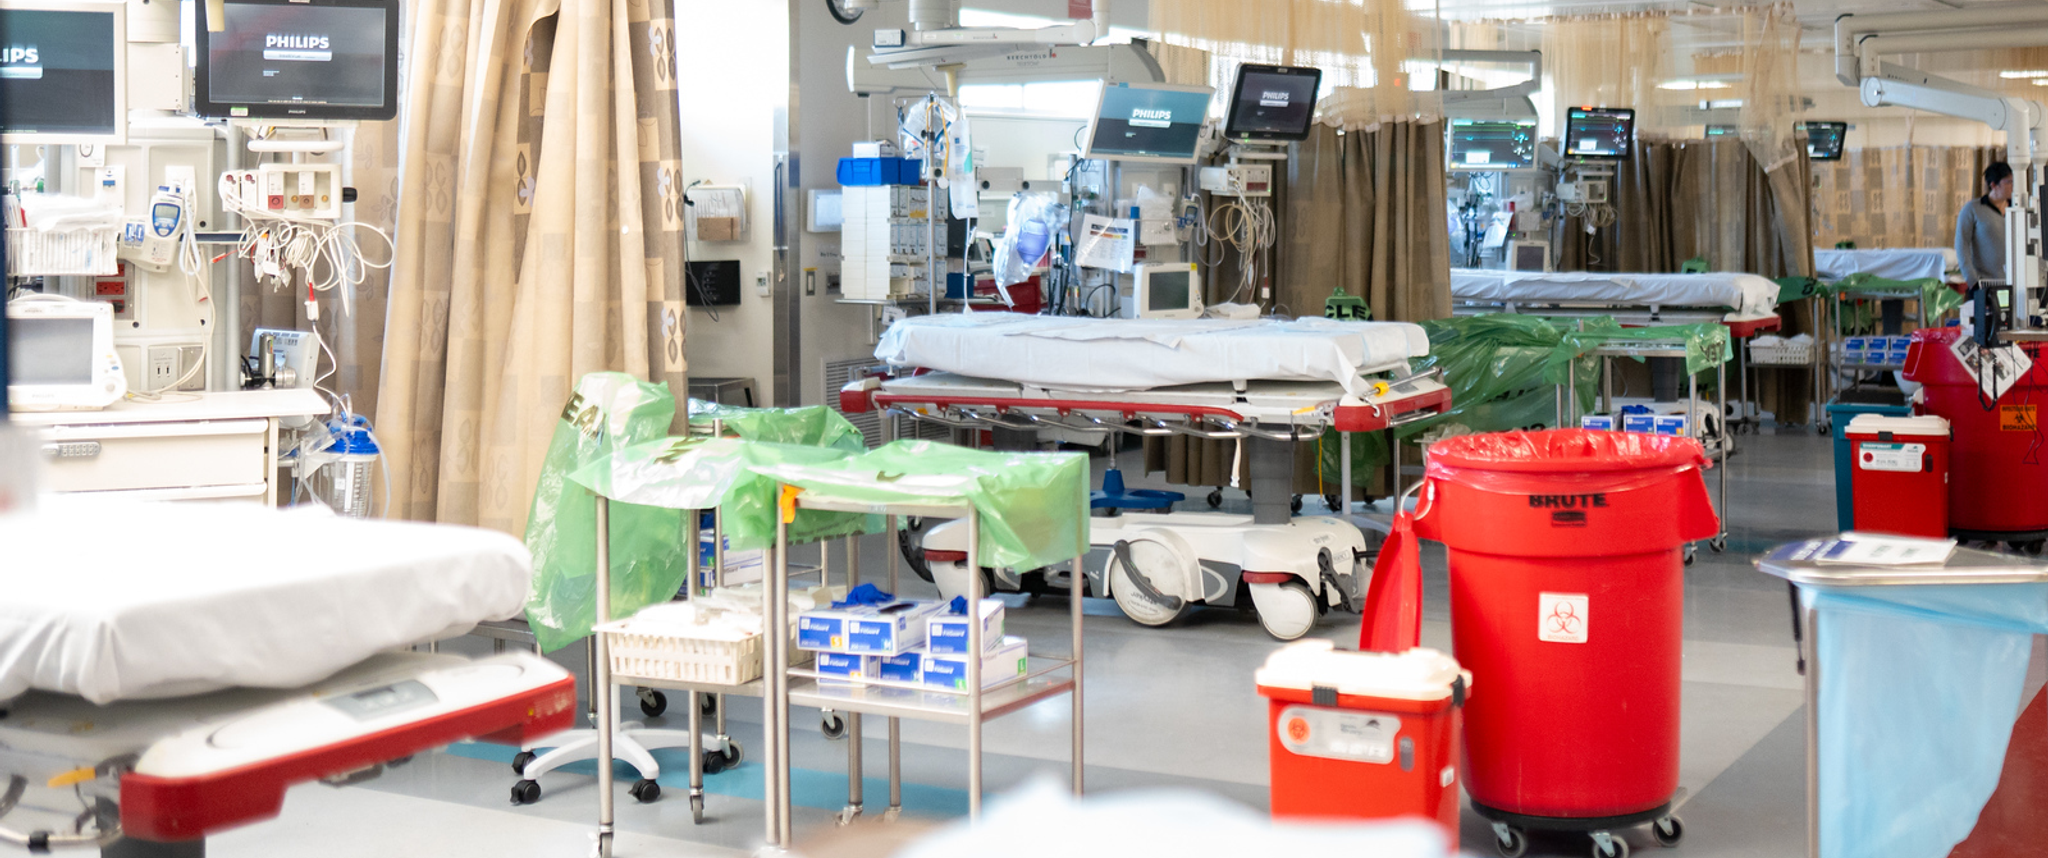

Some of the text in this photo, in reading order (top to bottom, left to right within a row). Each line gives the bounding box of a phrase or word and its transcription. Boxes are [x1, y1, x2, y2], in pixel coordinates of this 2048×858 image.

[266, 35, 330, 49] PHILIPS
[0, 48, 39, 63] IPS
[1262, 91, 1290, 100] PHILIPS
[1132, 108, 1172, 120] PHILIPS
[1325, 304, 1374, 321] CLE
[1529, 493, 1608, 508] BRUTE
